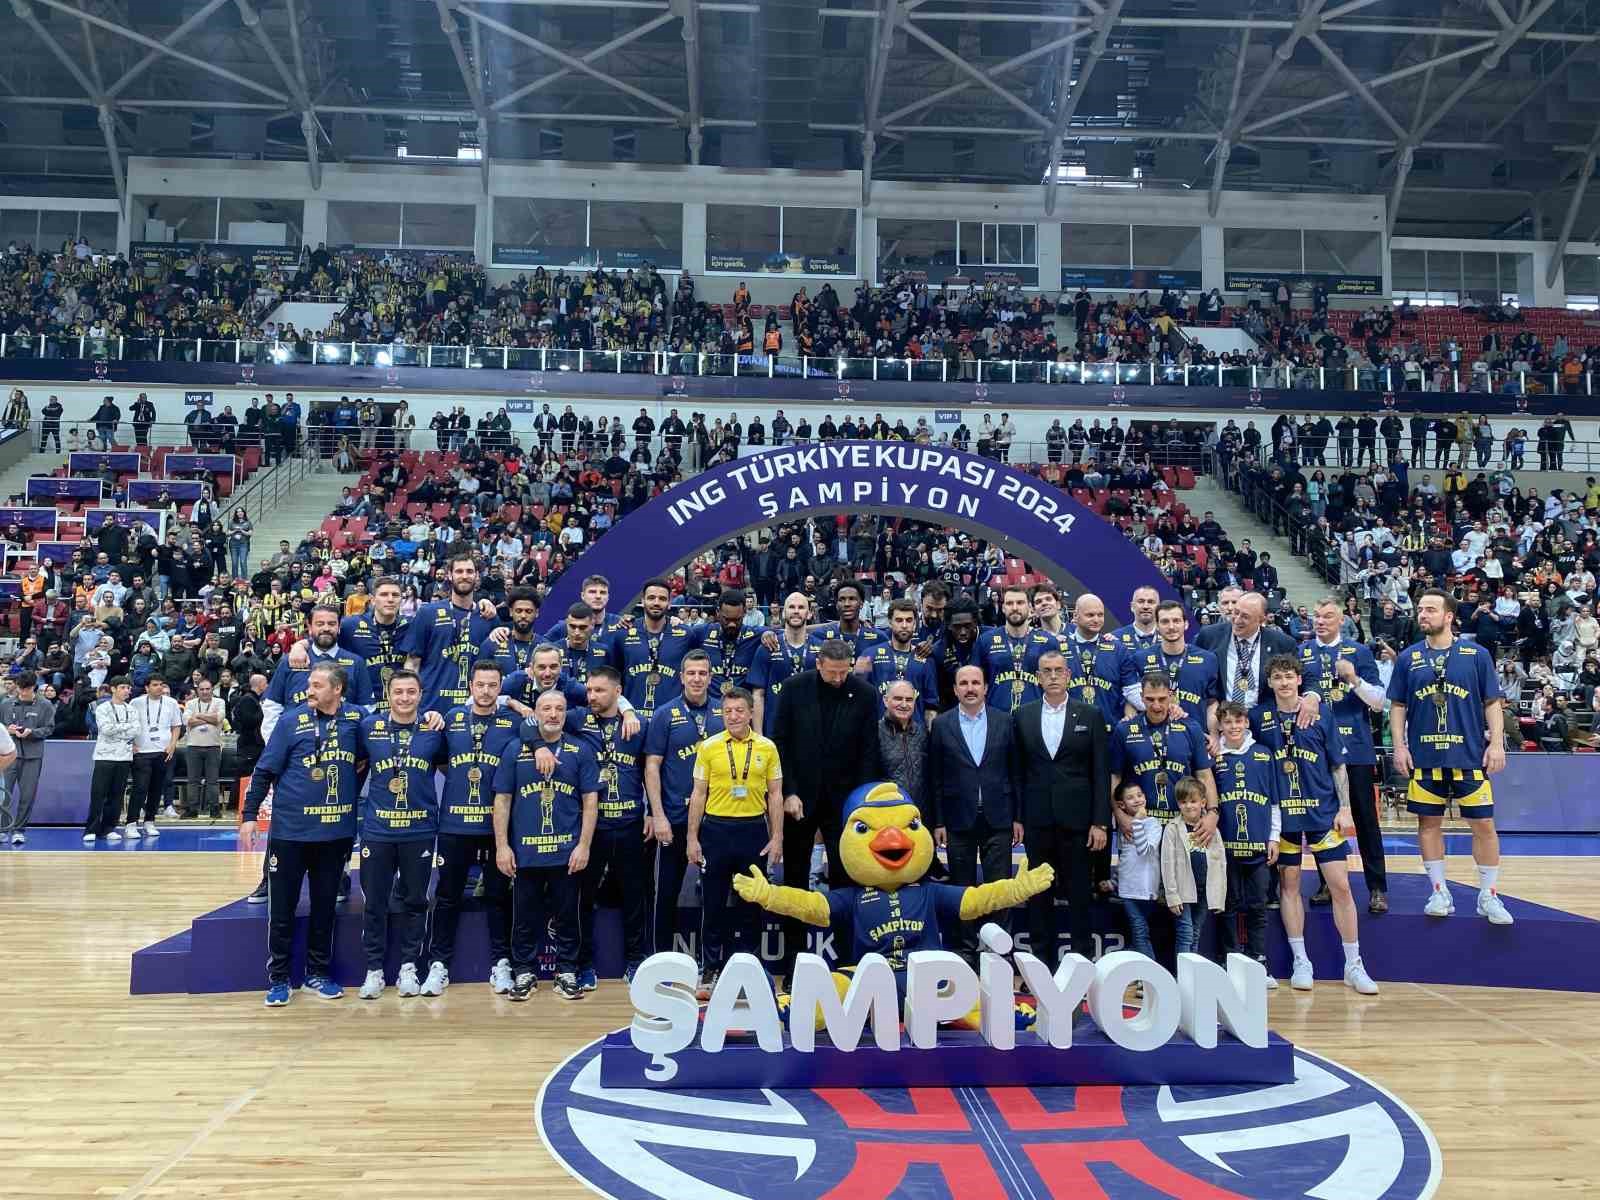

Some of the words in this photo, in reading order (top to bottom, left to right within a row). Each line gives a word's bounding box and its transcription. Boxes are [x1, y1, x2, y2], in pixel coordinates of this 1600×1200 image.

[666, 479, 727, 526] ING
[726, 442, 870, 491] TÜRKİYE
[875, 445, 996, 490] KUPASI
[997, 475, 1076, 535] 2024
[758, 476, 980, 519] ŞAMPİYON
[630, 922, 1268, 1082] ŞAMPİYON
